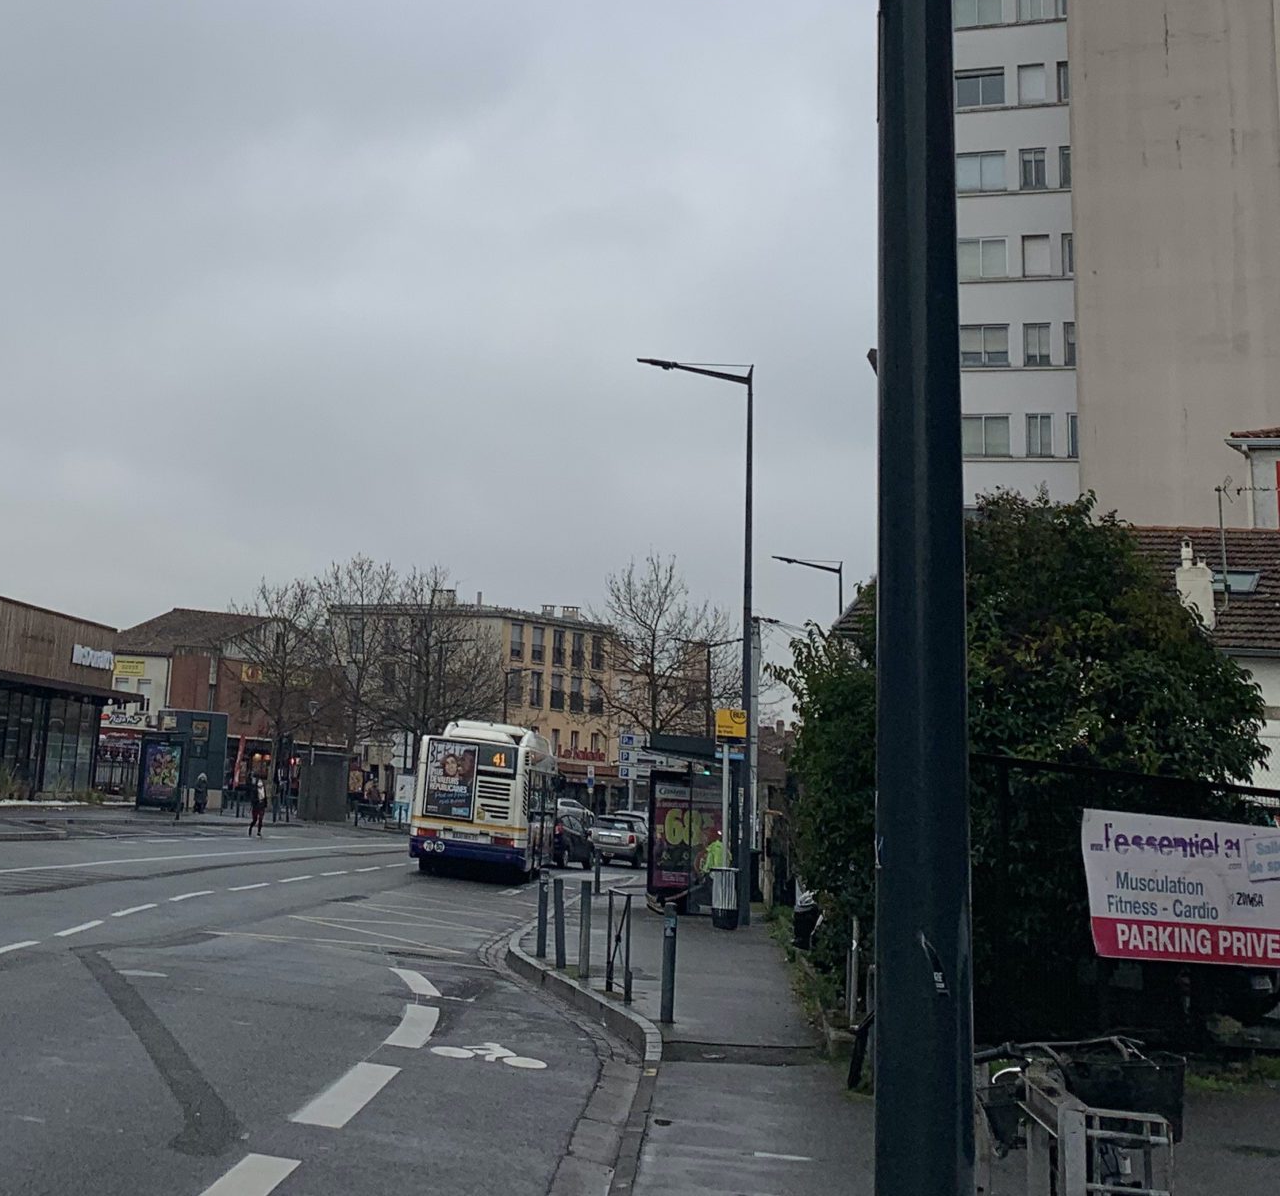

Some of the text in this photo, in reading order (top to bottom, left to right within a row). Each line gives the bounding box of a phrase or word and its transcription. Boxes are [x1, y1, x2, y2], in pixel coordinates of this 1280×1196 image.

[732, 711, 746, 719] BUS
[492, 753, 506, 767] 41
[1116, 871, 1203, 896] Musculation
[1107, 895, 1158, 916] Fitness
[1173, 899, 1219, 920] Cardio
[1116, 923, 1212, 954] PARKING
